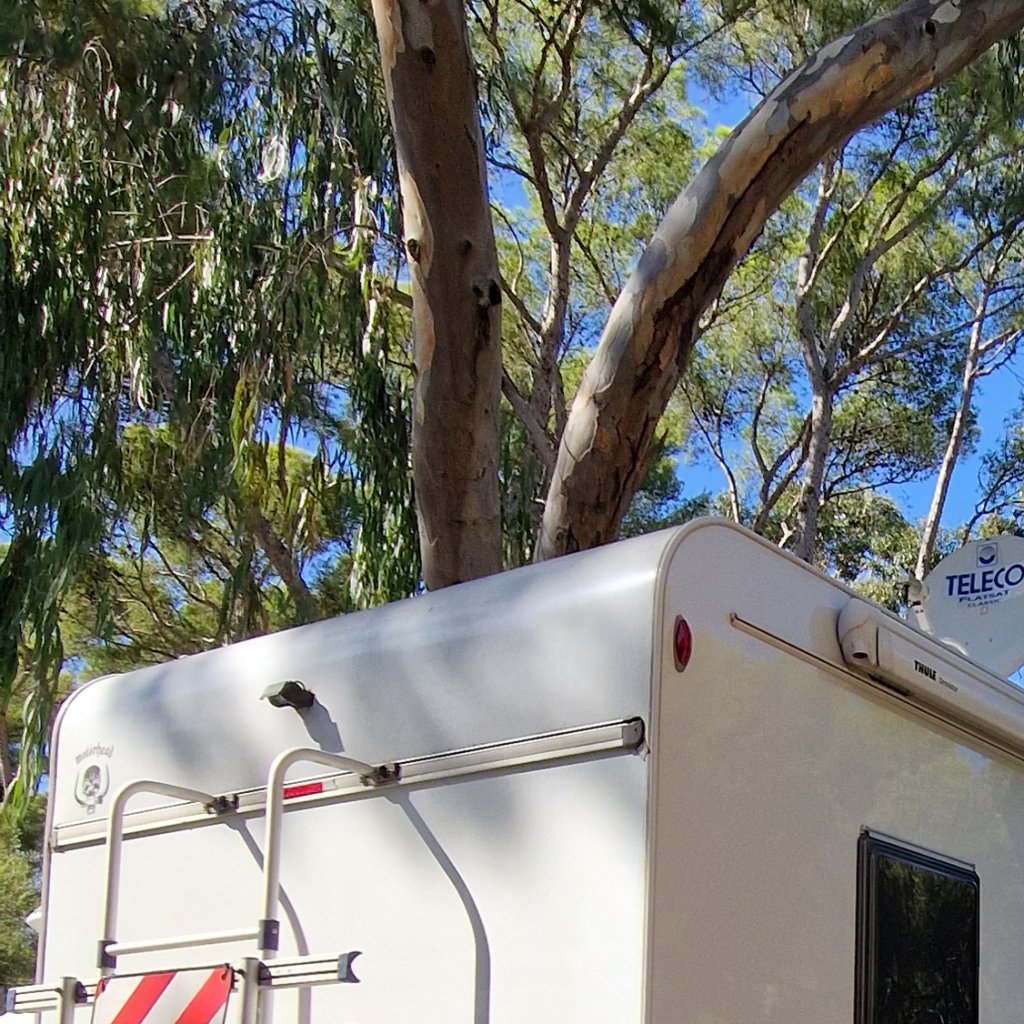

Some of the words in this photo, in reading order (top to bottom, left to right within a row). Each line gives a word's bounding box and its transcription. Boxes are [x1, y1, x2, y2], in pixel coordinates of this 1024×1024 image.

[946, 564, 1024, 596] TELECO
[959, 590, 1009, 603] FLATSAT
[914, 660, 937, 681] THULE
